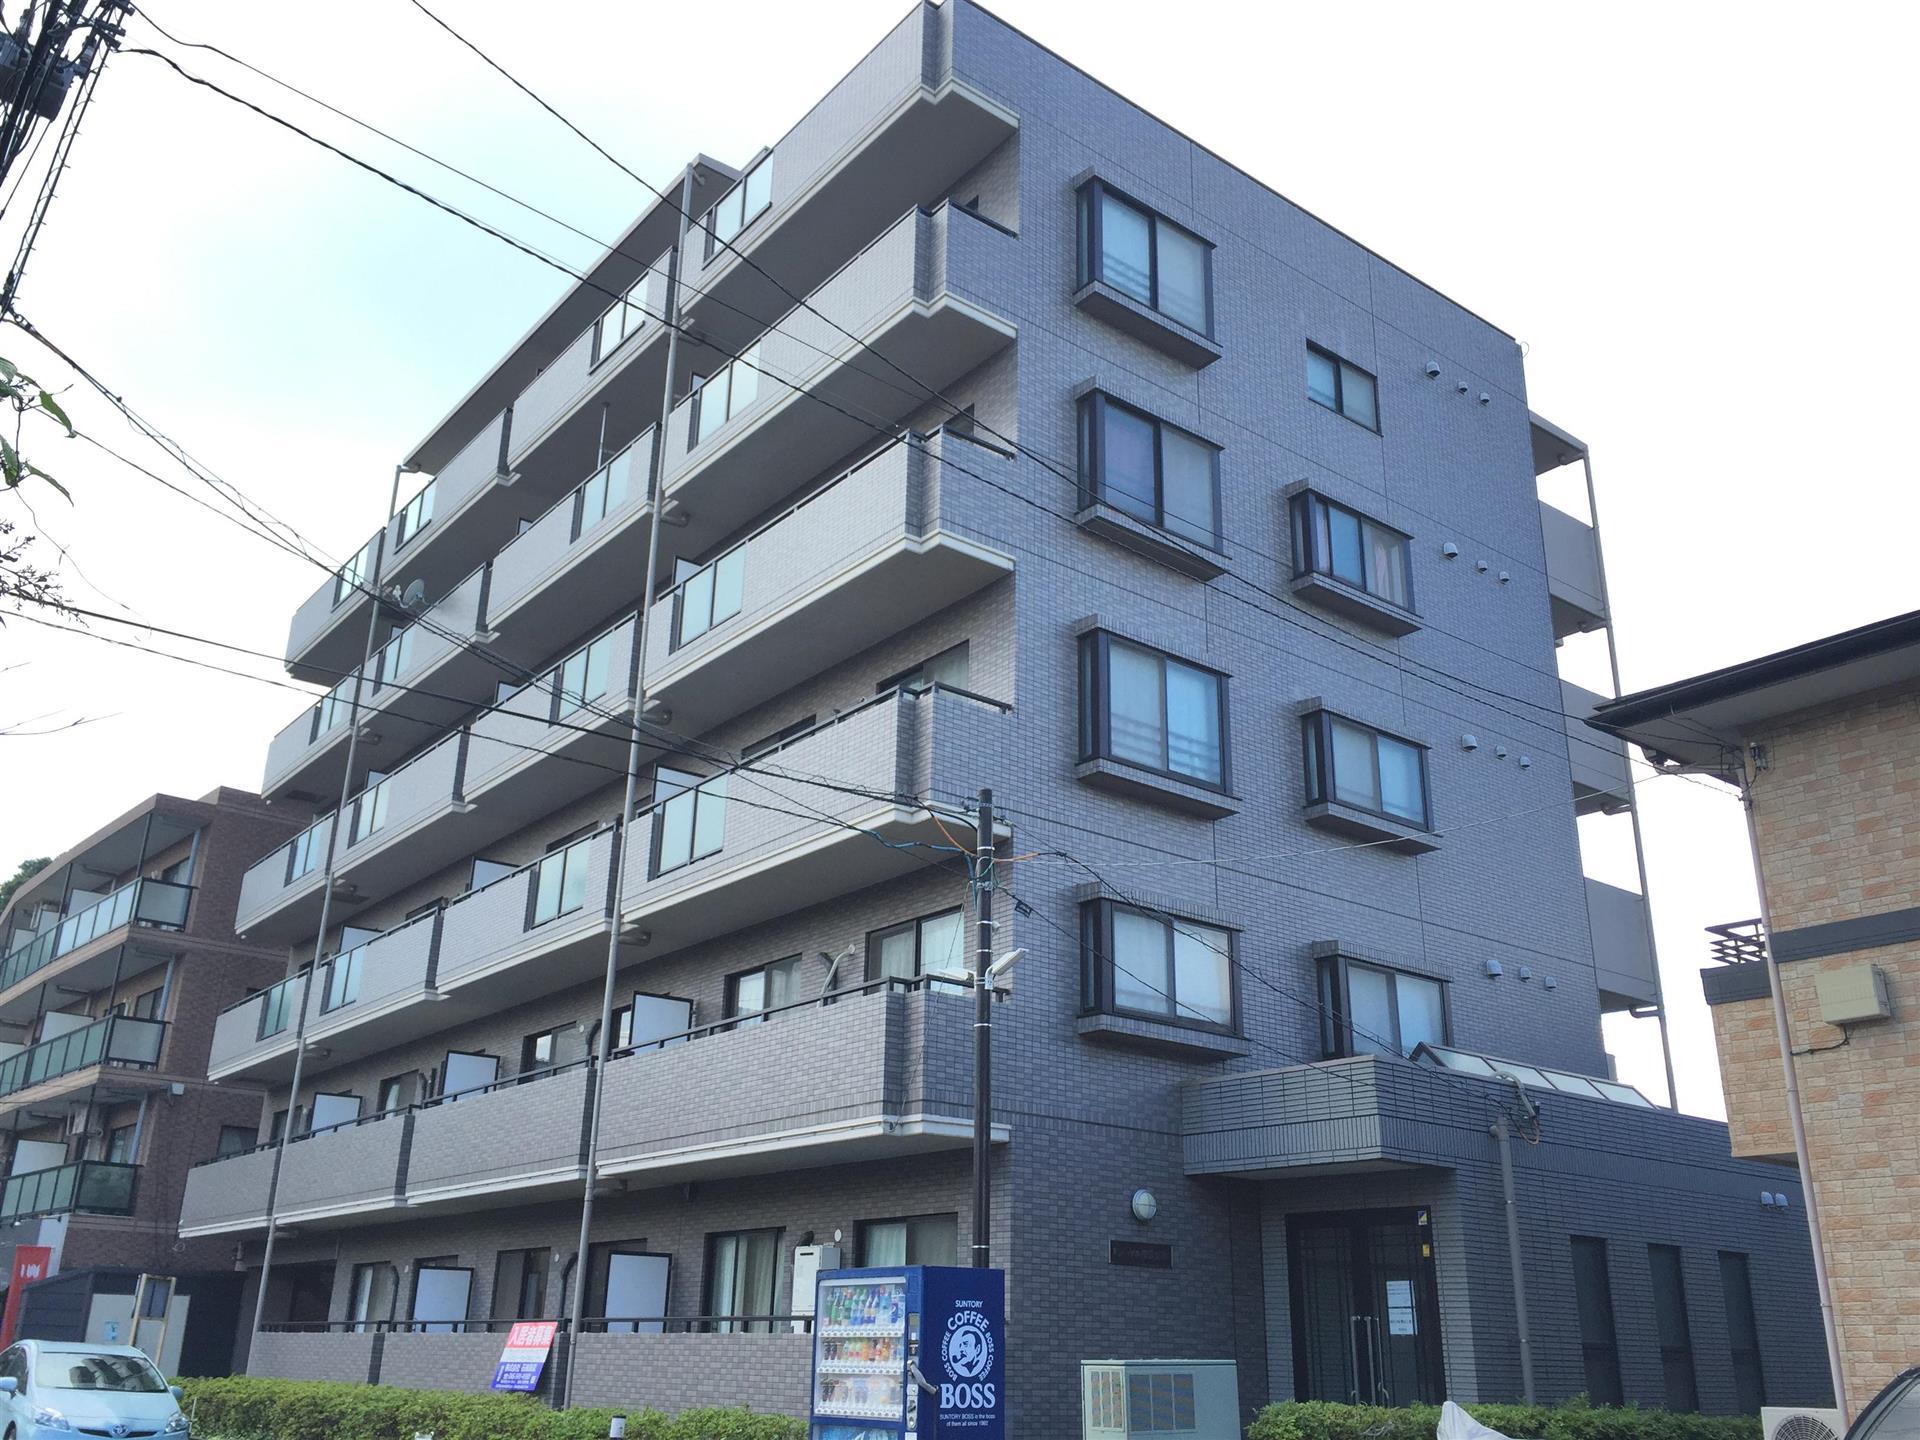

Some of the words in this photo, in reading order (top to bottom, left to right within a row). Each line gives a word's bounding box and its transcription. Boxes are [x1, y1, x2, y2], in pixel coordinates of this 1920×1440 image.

[955, 1300, 983, 1308] SUNTORY
[947, 1310, 990, 1332] COFFEE
[941, 1331, 952, 1361] COFFEE
[985, 1332, 995, 1353] BOSS
[944, 1362, 958, 1381] BOSS
[978, 1354, 994, 1381] COFFEE
[940, 1383, 996, 1409] BOSS
